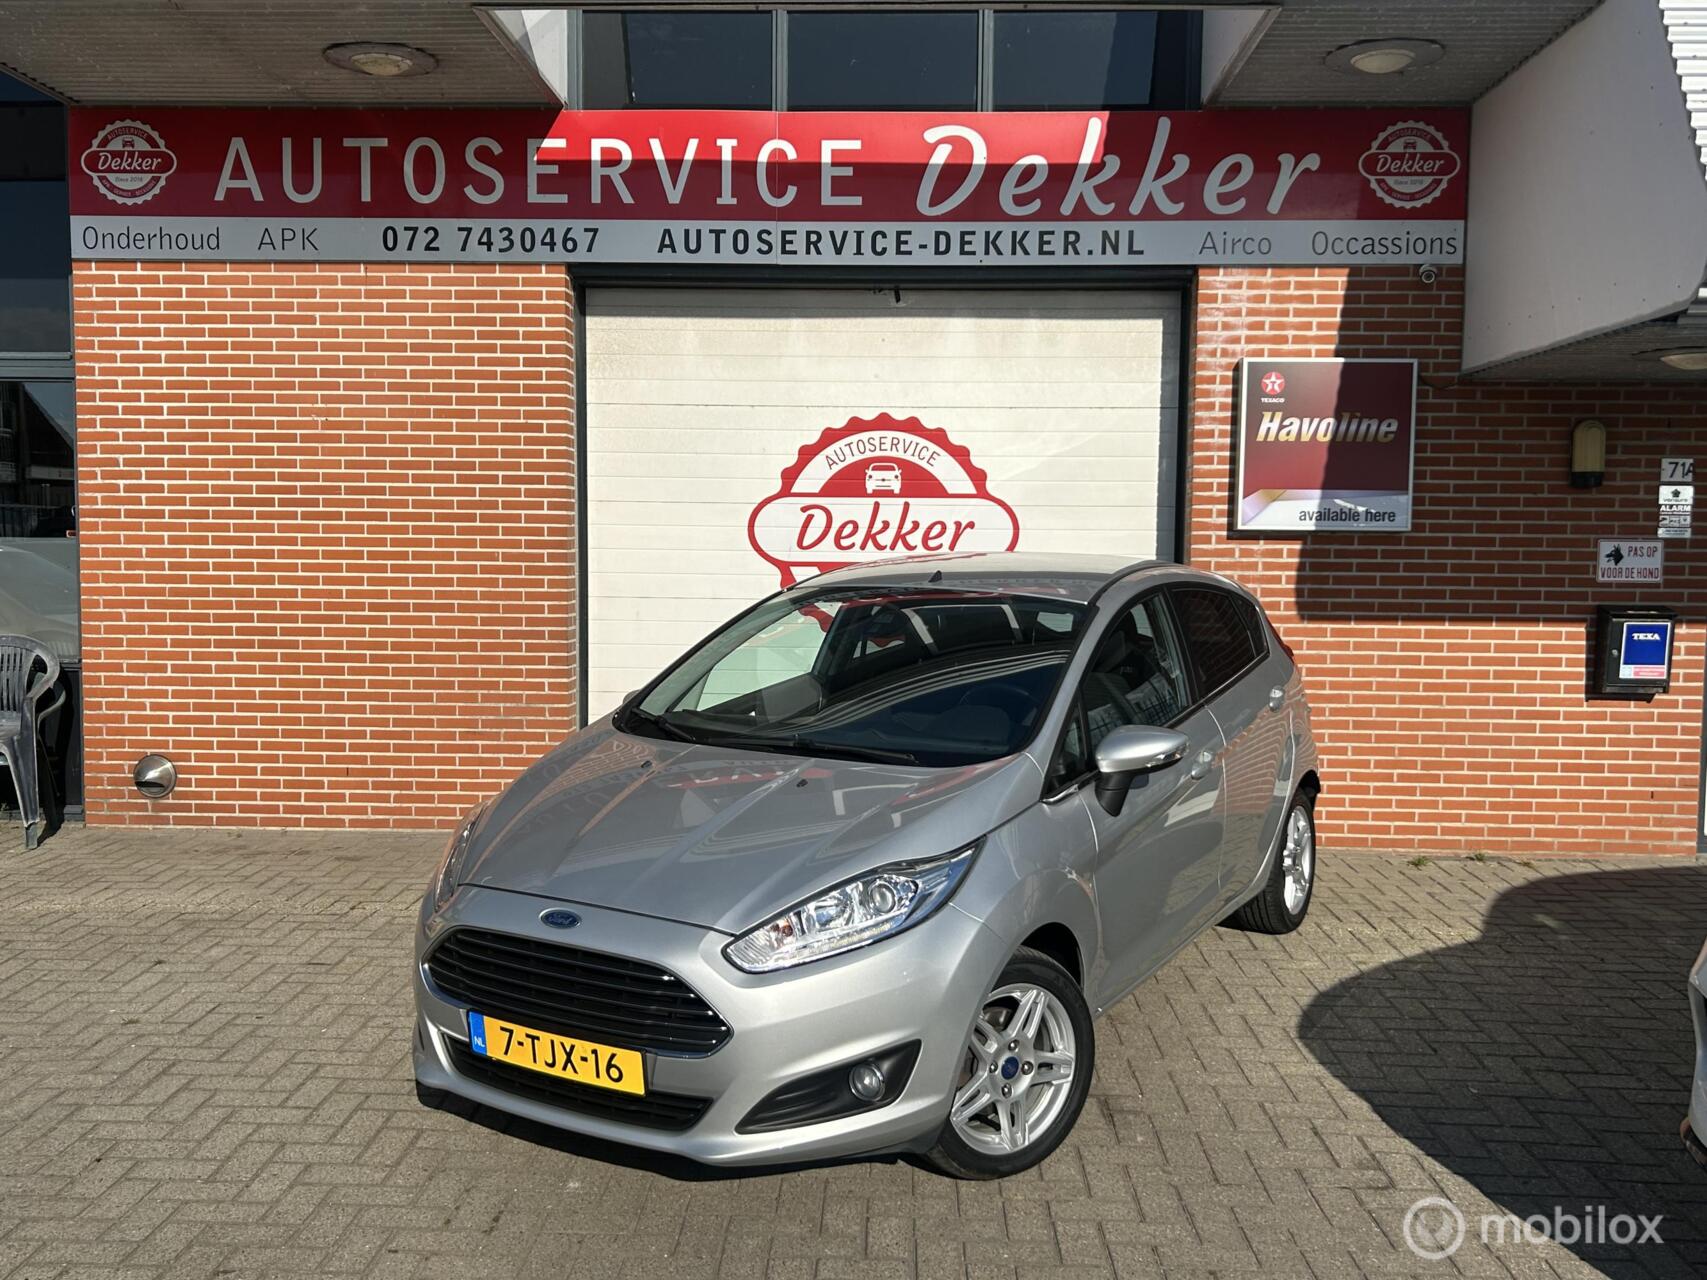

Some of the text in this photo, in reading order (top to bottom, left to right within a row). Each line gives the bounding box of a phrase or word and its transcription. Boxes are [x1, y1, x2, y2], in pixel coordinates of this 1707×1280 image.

[98, 151, 162, 170] Dekker
[213, 116, 1321, 217] AUTOSERVICE Dekker
[1376, 153, 1445, 173] Dekker
[82, 226, 220, 251] Onderhoud
[258, 228, 319, 251] APK
[382, 226, 600, 252] 072 7430467
[657, 228, 1146, 256] AUTOSERVICE-DEKKER.NL
[1199, 231, 1272, 256] Airco
[1311, 231, 1457, 256] Occassions
[1256, 411, 1399, 443] Havoline
[825, 436, 941, 470] AUTOSERVICE
[796, 501, 975, 551] Dekker
[1299, 507, 1396, 523] available here
[1628, 546, 1658, 558] PAS OP
[1600, 567, 1659, 579] VOOR DE HOND
[473, 1036, 486, 1048] NL
[500, 1026, 623, 1083] 7-TJX-16
